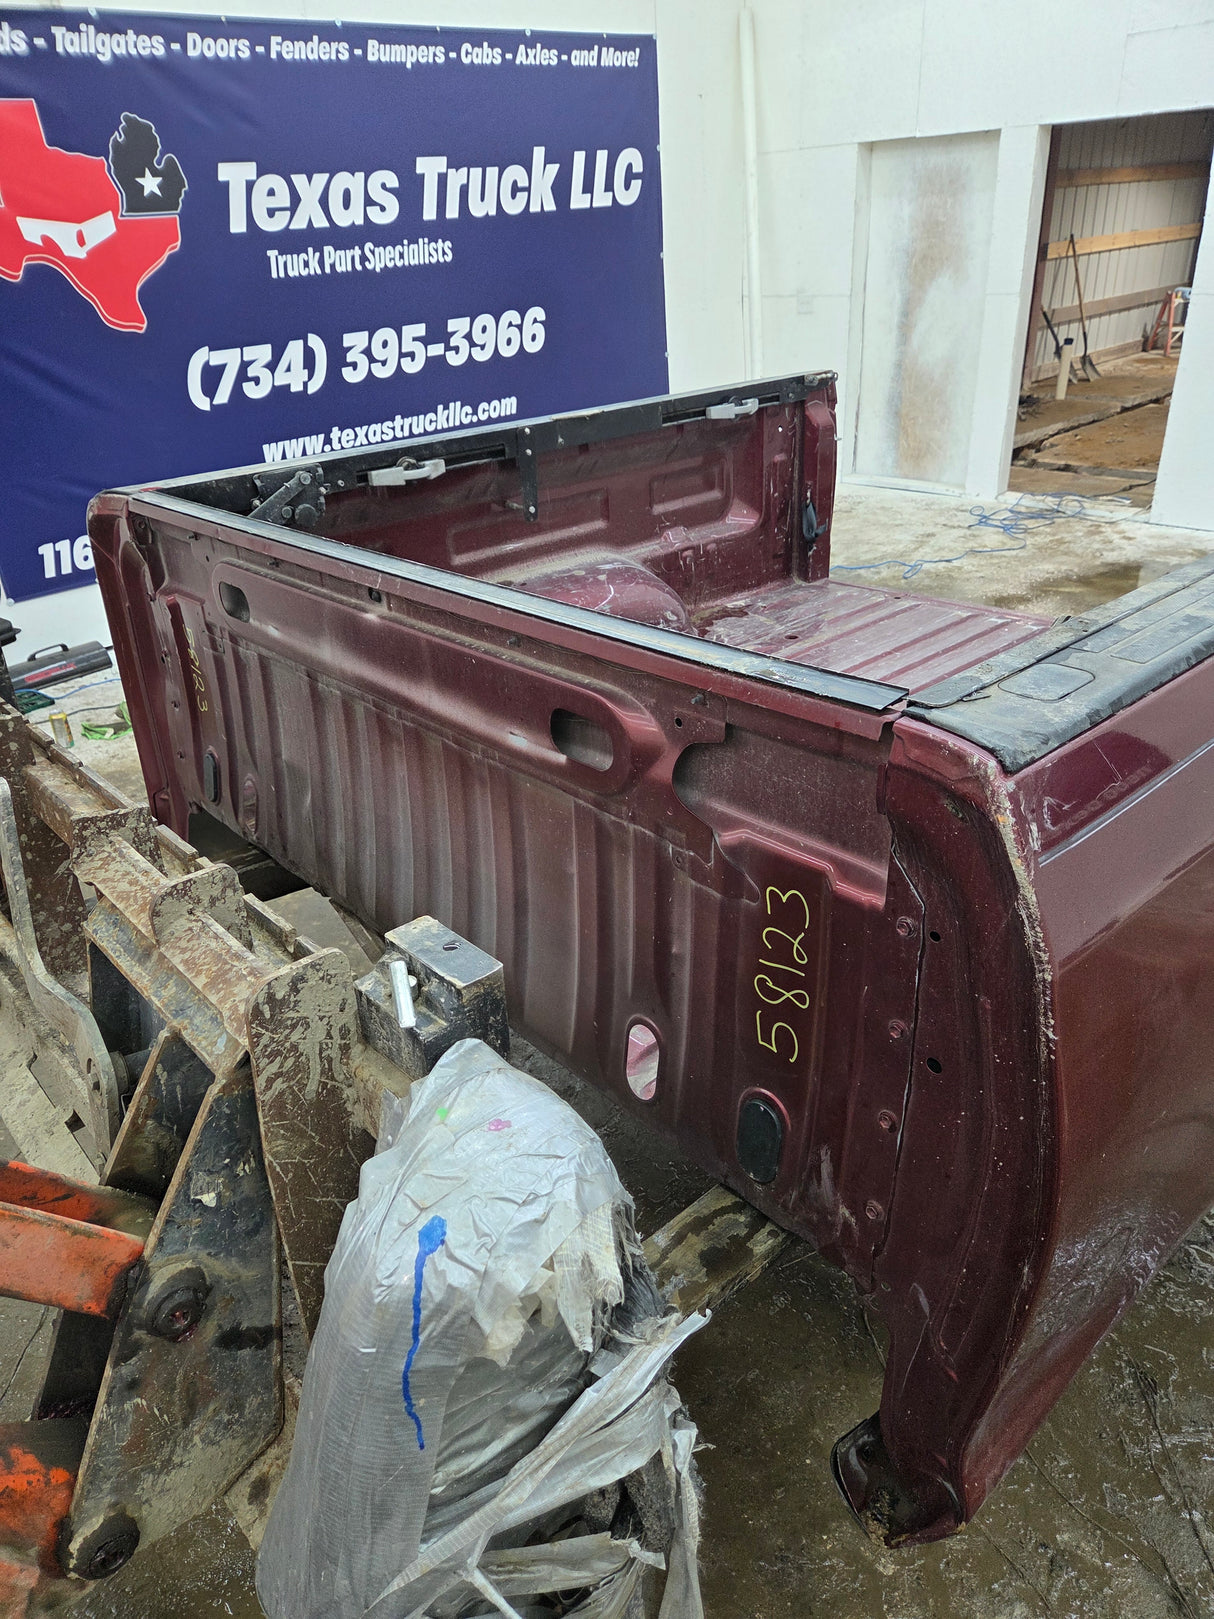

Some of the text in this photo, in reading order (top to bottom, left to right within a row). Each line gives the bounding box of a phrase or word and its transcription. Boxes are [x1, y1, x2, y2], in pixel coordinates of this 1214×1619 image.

[51, 23, 166, 62] Tailgates
[186, 32, 251, 58] Doors
[270, 35, 350, 61] Fenders
[367, 39, 446, 69] Bumpers
[460, 42, 501, 65] Cabs
[515, 43, 558, 66] Axles
[571, 45, 599, 67] and
[600, 47, 641, 68] More!
[217, 145, 644, 234] Texas Truck LLC
[266, 237, 453, 280] Truck Part Specialists
[187, 306, 547, 411] (734) 395-3966
[262, 395, 518, 463] www.texastruckllc.com
[38, 534, 95, 579] 116
[754, 886, 810, 1063] 58123
